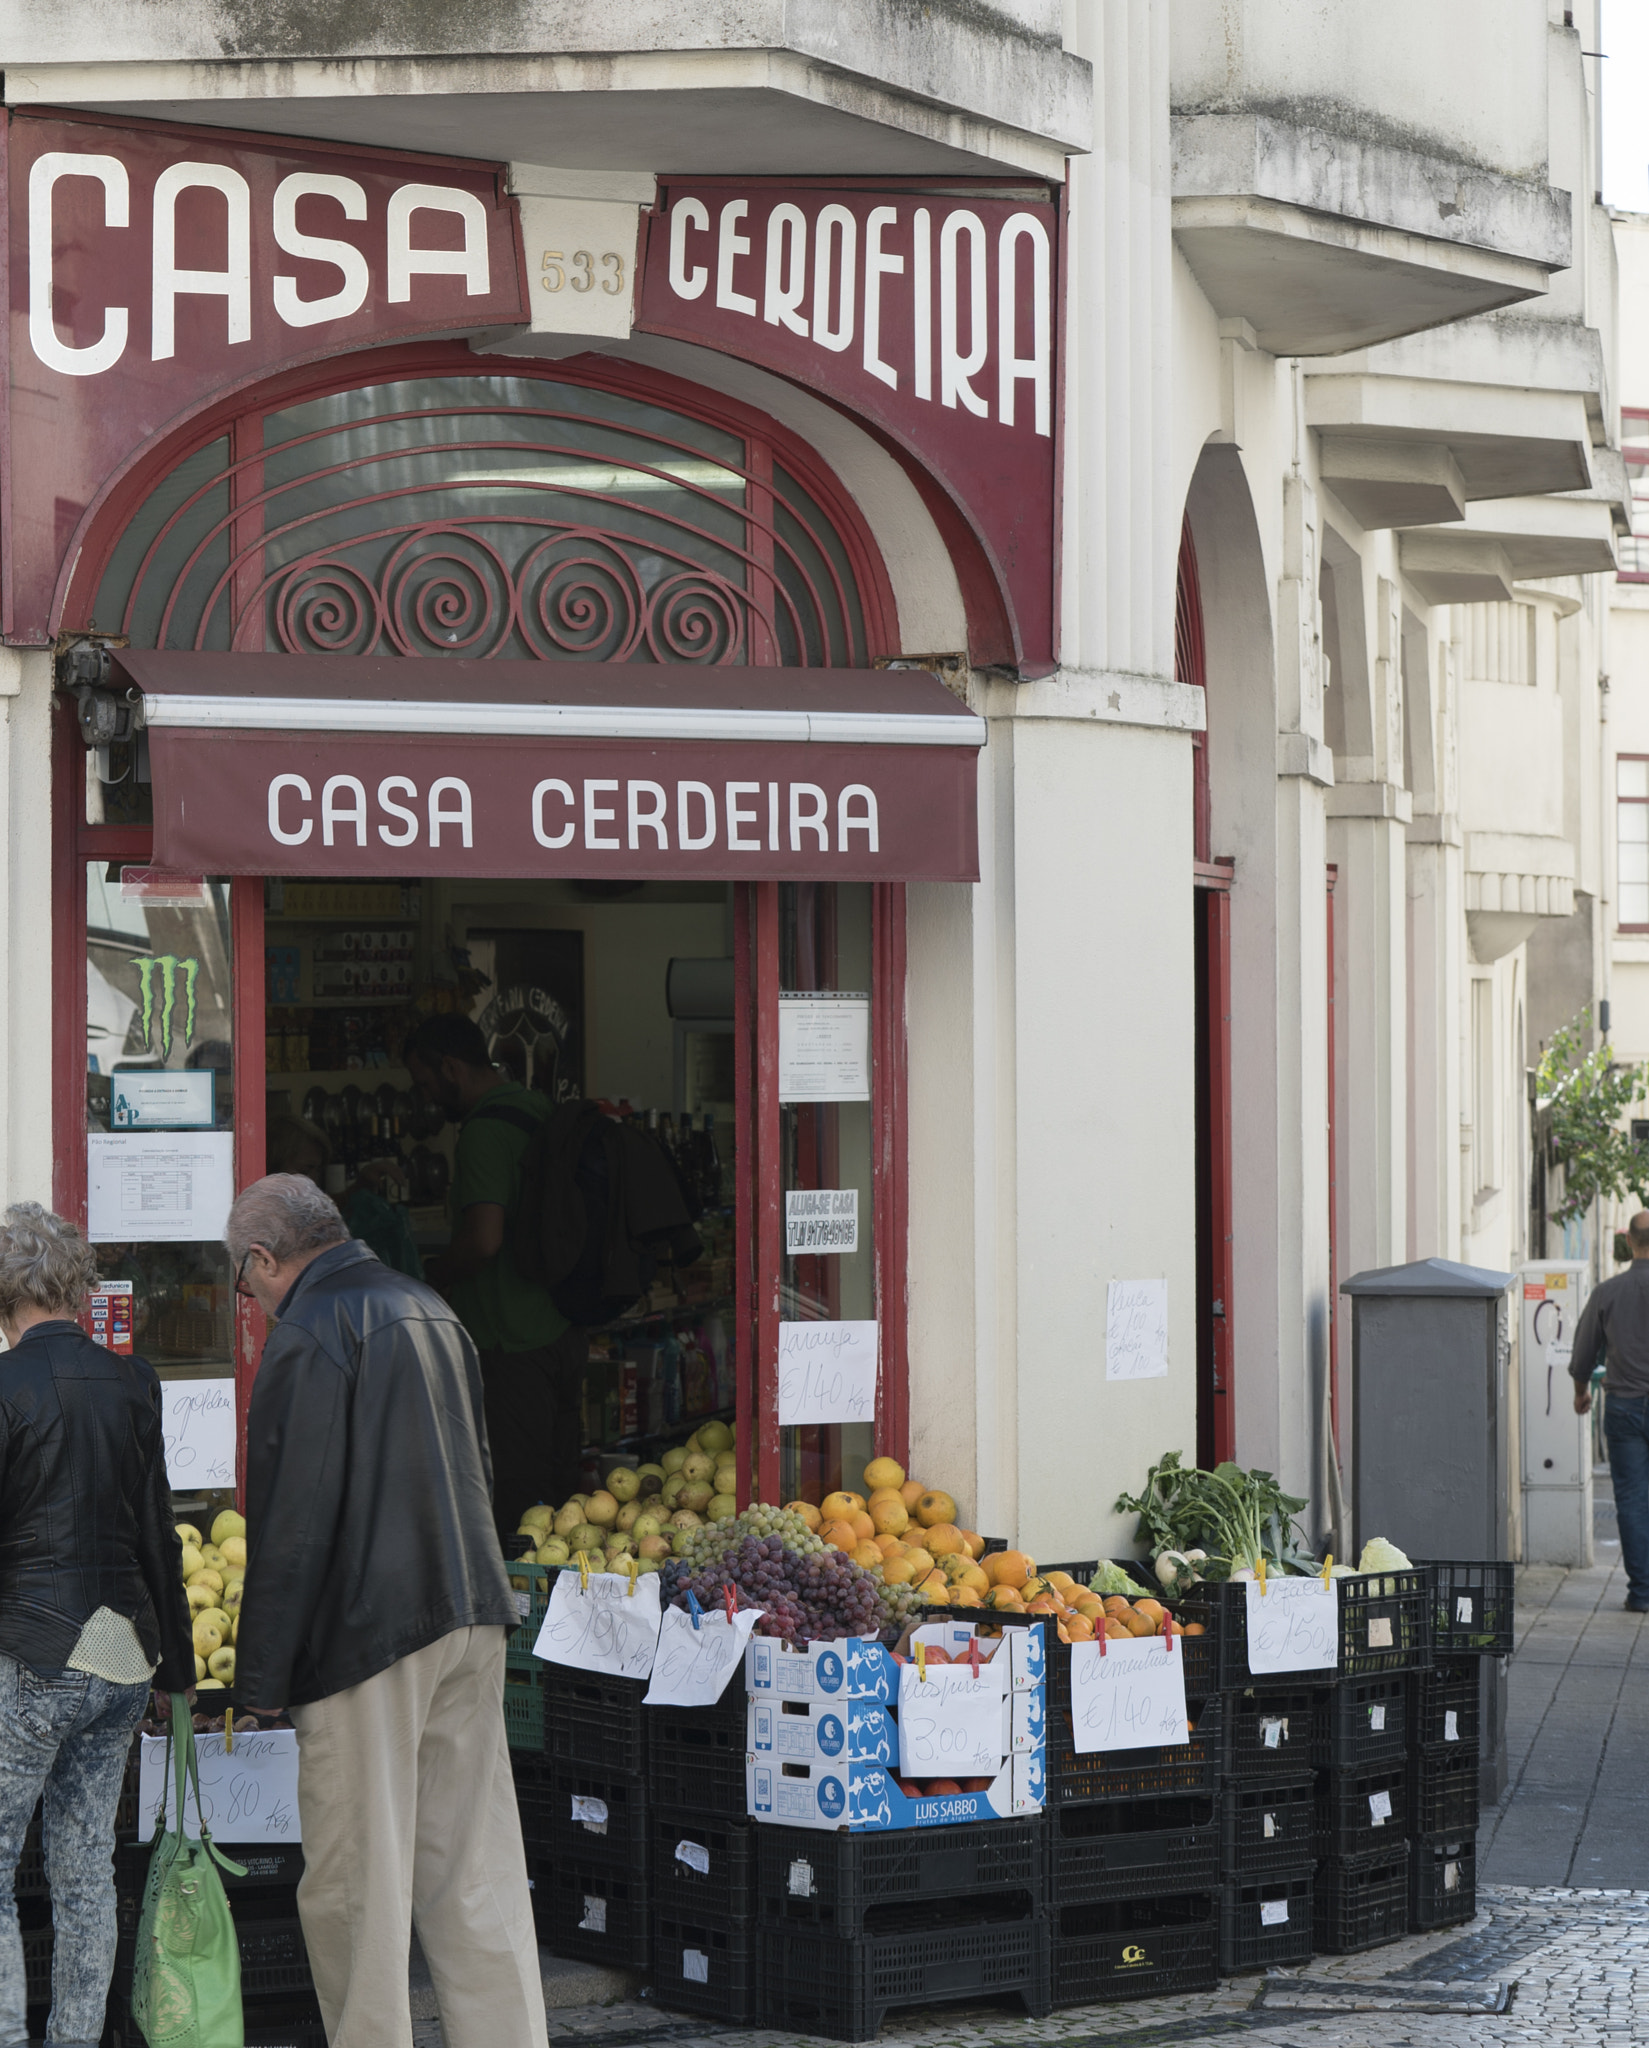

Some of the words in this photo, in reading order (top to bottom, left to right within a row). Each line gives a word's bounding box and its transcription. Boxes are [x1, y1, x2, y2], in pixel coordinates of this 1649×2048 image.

[541, 250, 626, 295] 533
[29, 152, 490, 376] CASA
[668, 196, 1051, 437] CERDEIRA
[267, 774, 474, 848] CASA
[531, 778, 880, 853] CERDEIRA
[103, 1138, 127, 1146] Regional
[788, 1193, 831, 1216] ALUGA-SE
[832, 1192, 855, 1215] CASA
[787, 1221, 807, 1247] TLM
[915, 1802, 939, 1820] LUIS
[940, 1798, 978, 1817] SABBO
